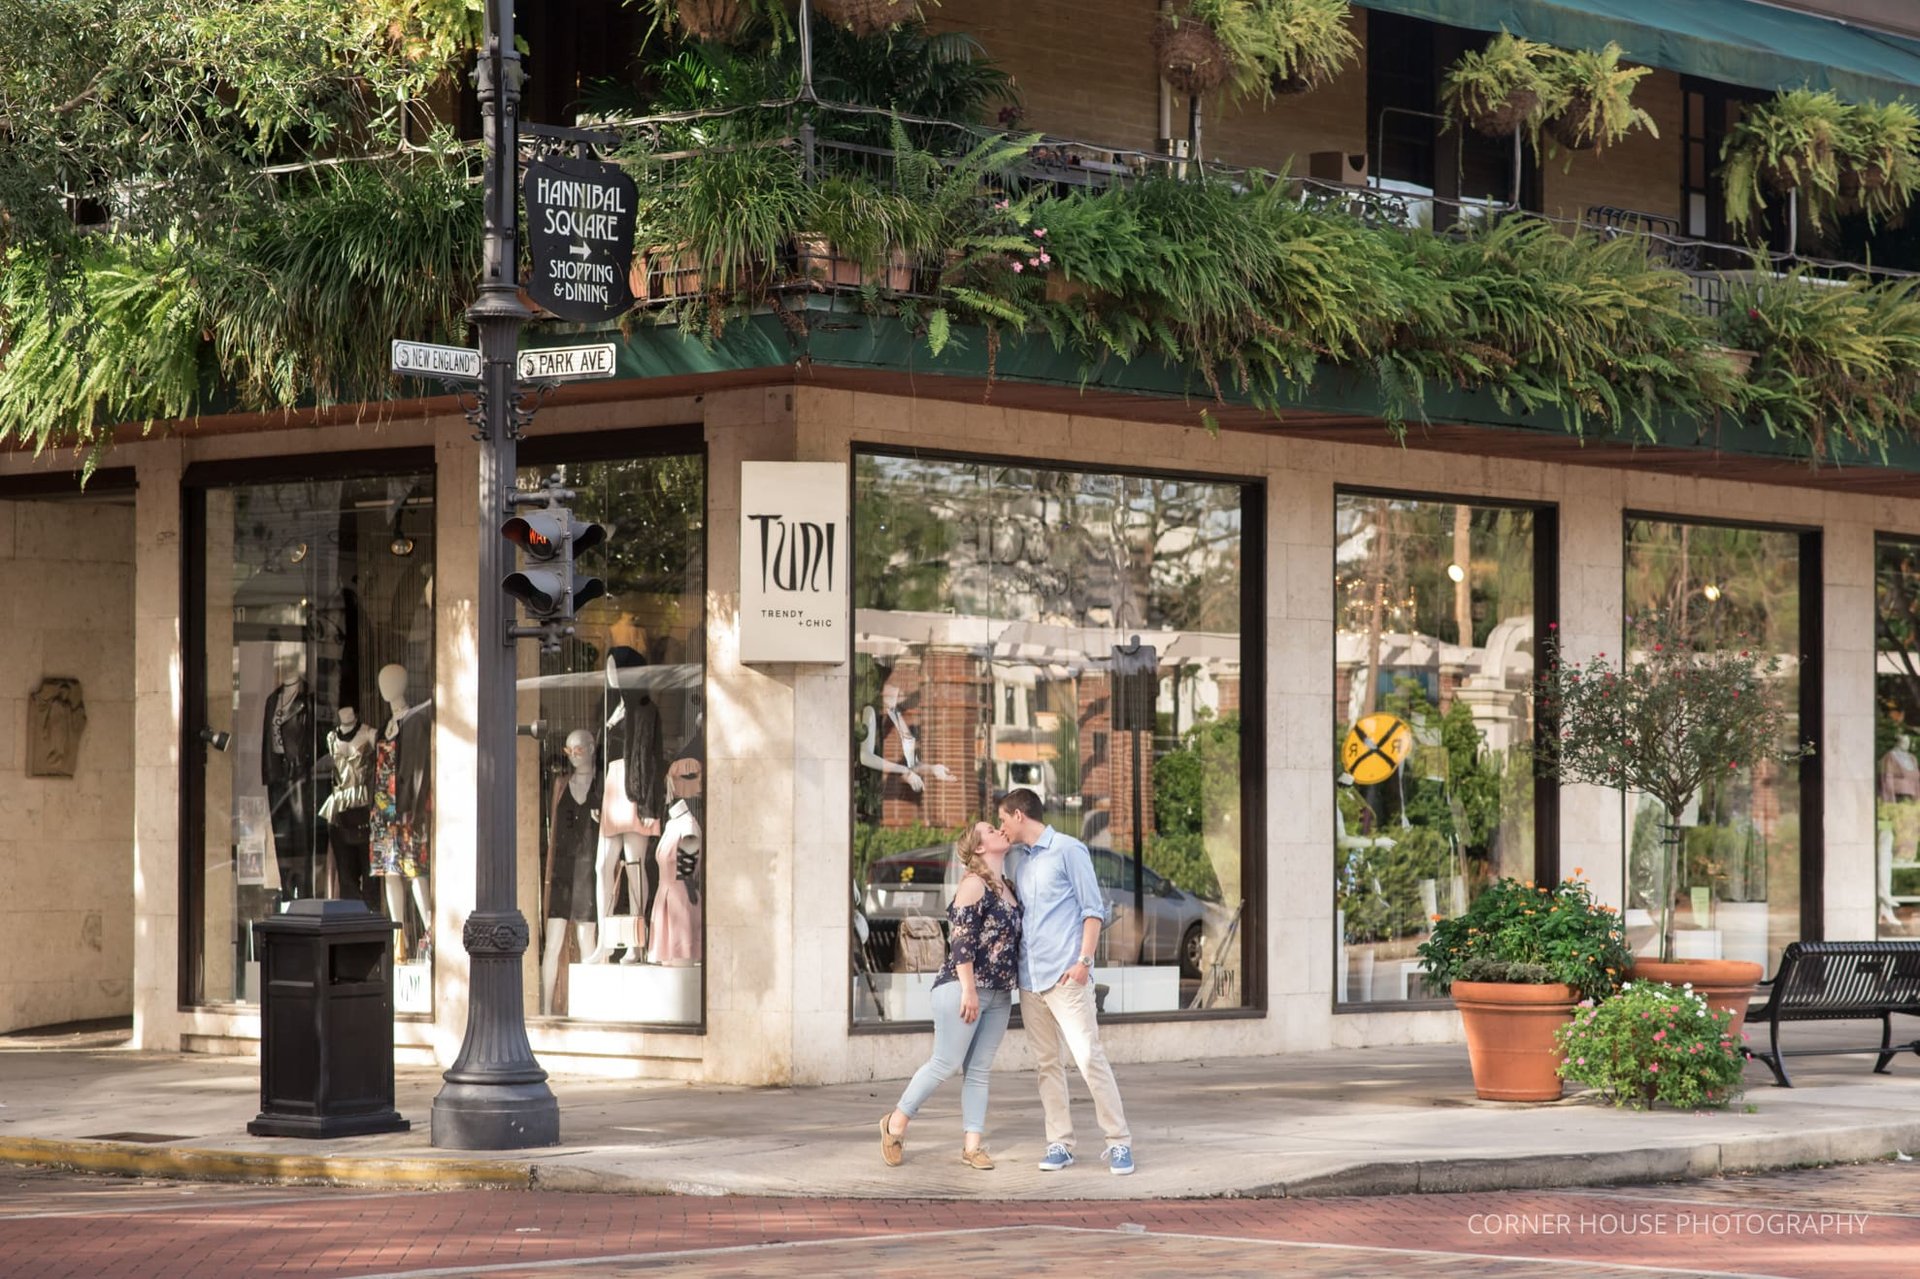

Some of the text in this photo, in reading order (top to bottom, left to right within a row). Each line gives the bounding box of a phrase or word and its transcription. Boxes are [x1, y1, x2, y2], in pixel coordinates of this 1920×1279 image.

[537, 177, 626, 214] HANNIBAL
[543, 208, 619, 242] SQUARE
[549, 259, 614, 284] SHOPPING
[412, 348, 430, 368] NEW
[432, 350, 470, 373] ENGLAND
[539, 352, 574, 375] PARK
[580, 350, 606, 371] AVE
[761, 610, 804, 618] TRENDY
